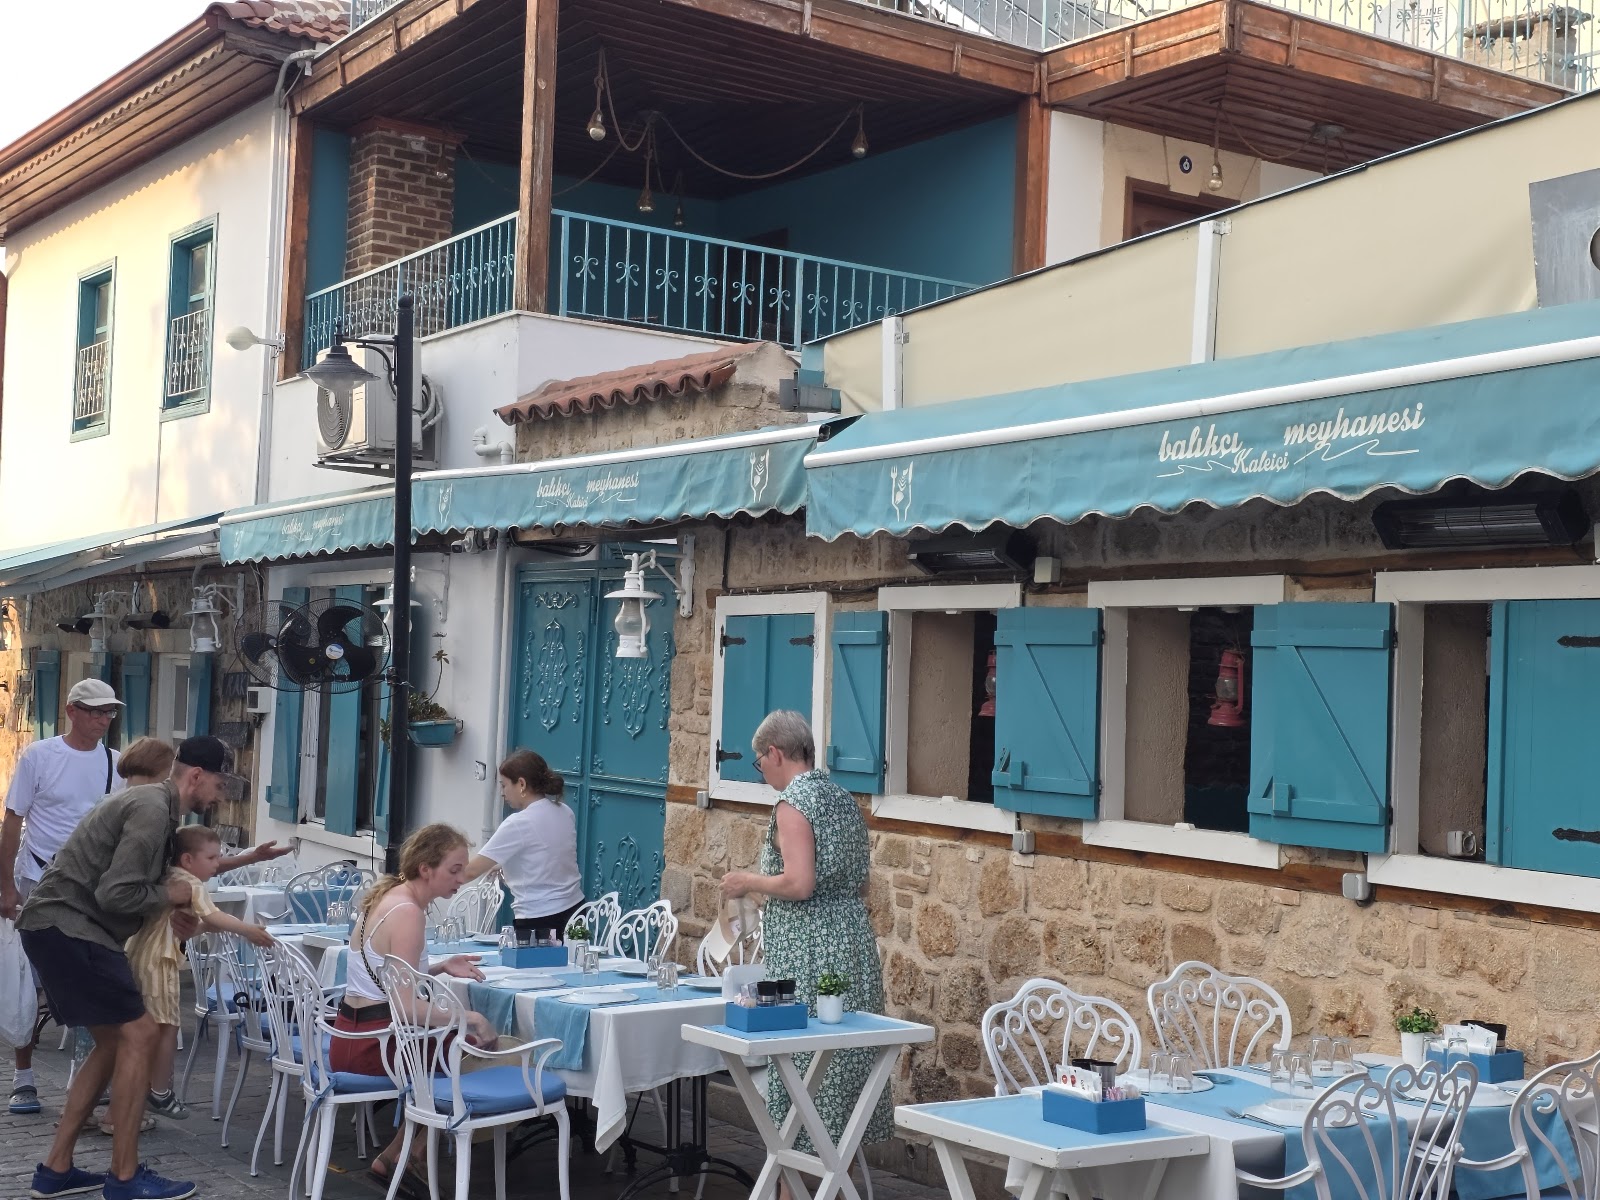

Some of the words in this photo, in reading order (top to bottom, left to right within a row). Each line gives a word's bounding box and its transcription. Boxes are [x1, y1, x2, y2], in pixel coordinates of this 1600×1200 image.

[1158, 424, 1244, 463] balıkçı
[1284, 402, 1425, 450] meyhanesi
[1231, 448, 1290, 474] Kaleiçi
[586, 471, 639, 495] meyhanesi
